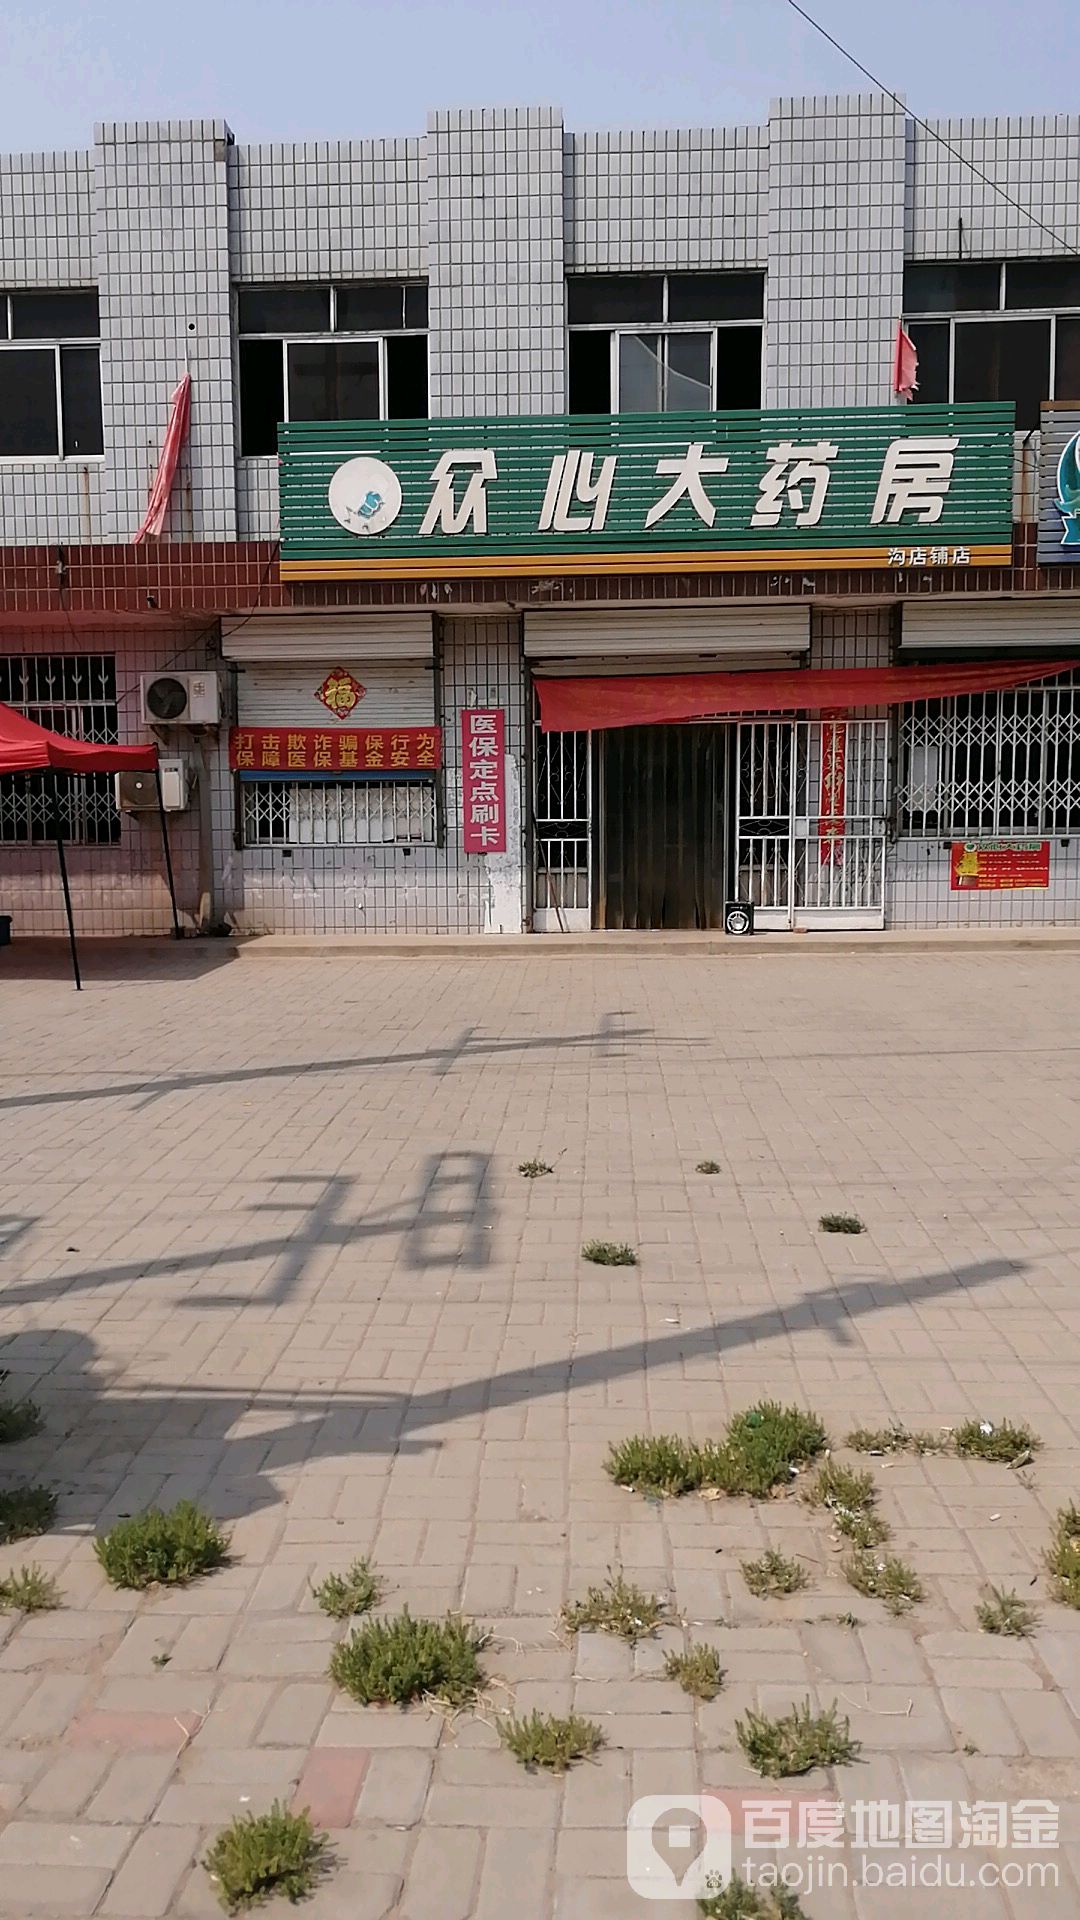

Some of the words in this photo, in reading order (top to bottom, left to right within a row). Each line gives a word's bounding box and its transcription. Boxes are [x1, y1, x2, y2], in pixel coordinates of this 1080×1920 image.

[419, 437, 959, 535] 众心大药房
[887, 547, 971, 565] 沟店铺店
[325, 677, 356, 709] 福
[235, 733, 435, 750] 打击欺诈骗保行为
[236, 751, 435, 767] 保障医保基金安全
[469, 714, 500, 846] 医保定点刷卡
